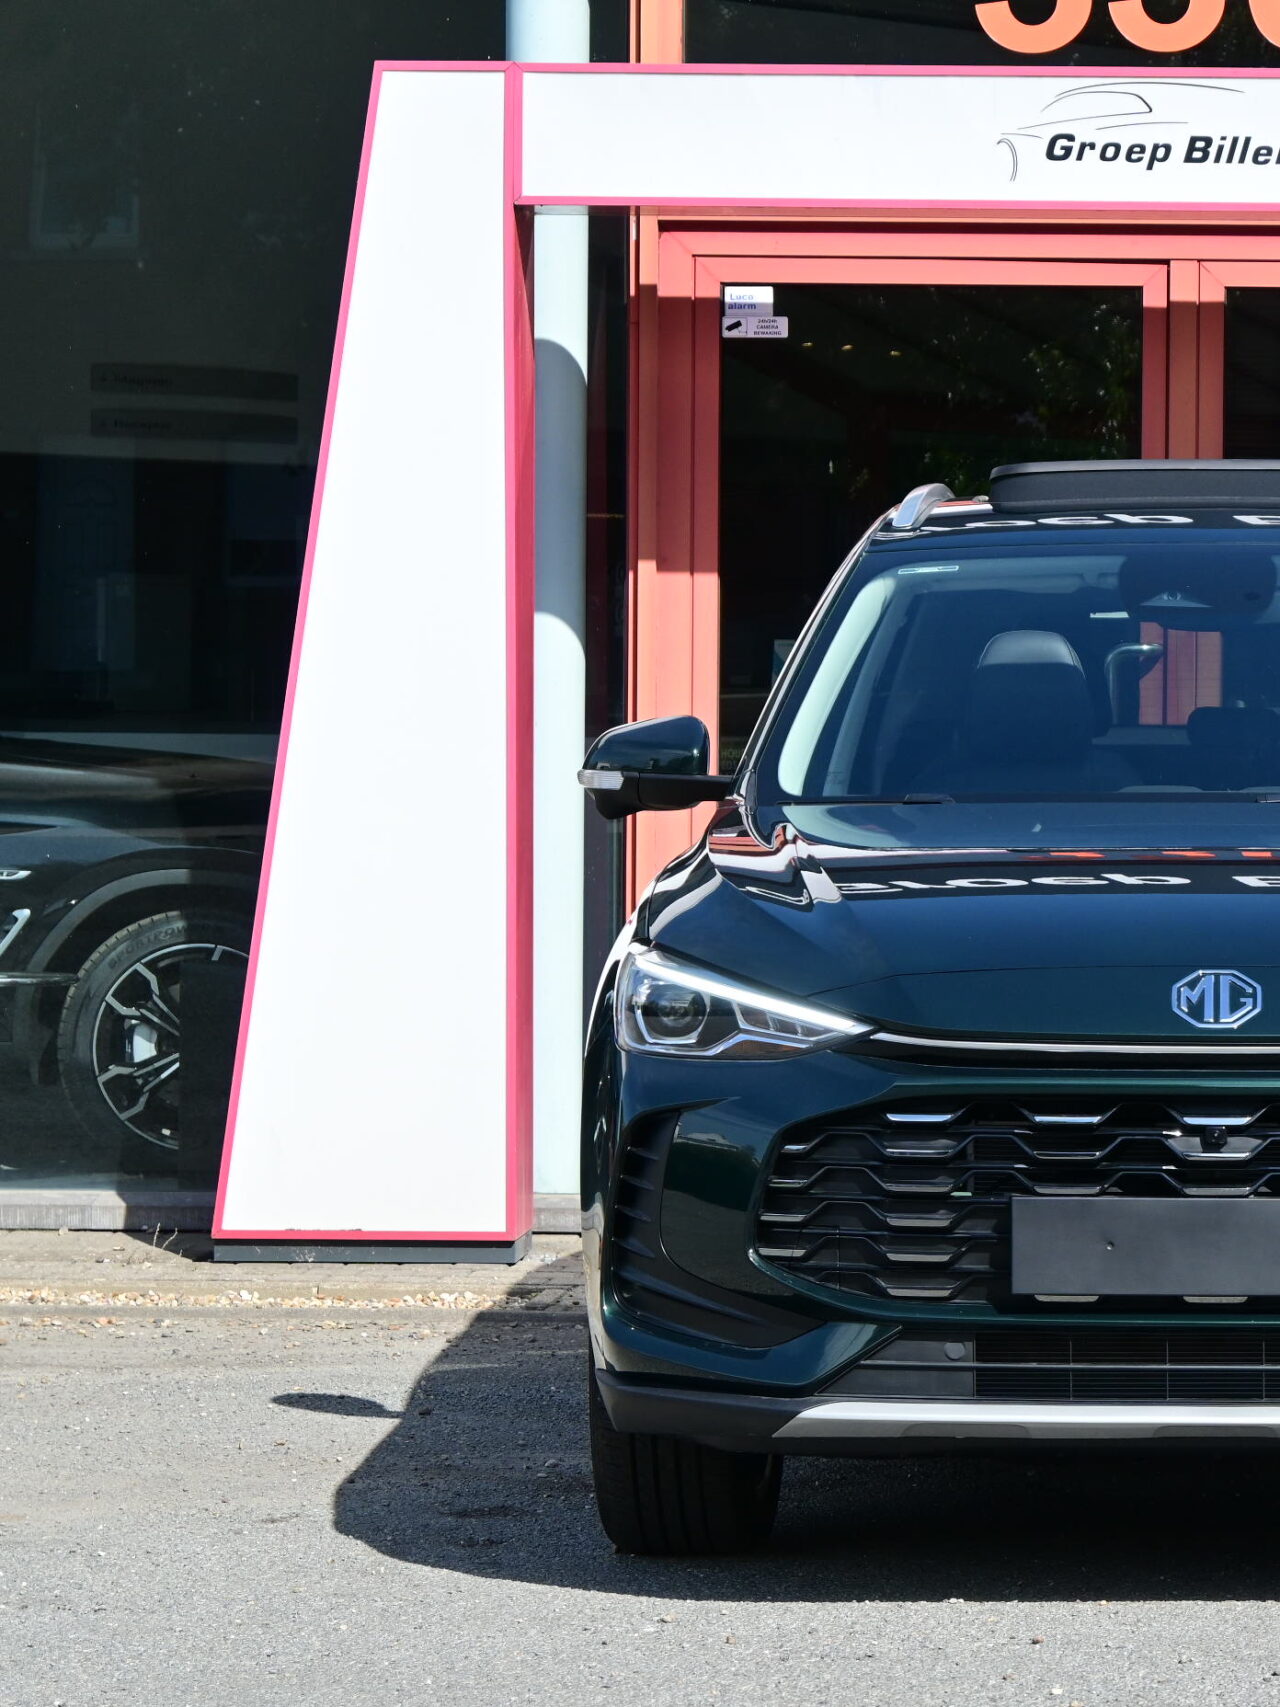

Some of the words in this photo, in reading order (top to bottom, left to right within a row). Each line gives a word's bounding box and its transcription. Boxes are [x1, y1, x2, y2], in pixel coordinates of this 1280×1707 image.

[1044, 132, 1173, 171] Groep
[727, 302, 757, 310] alarm
[1178, 972, 1256, 1024] MG
